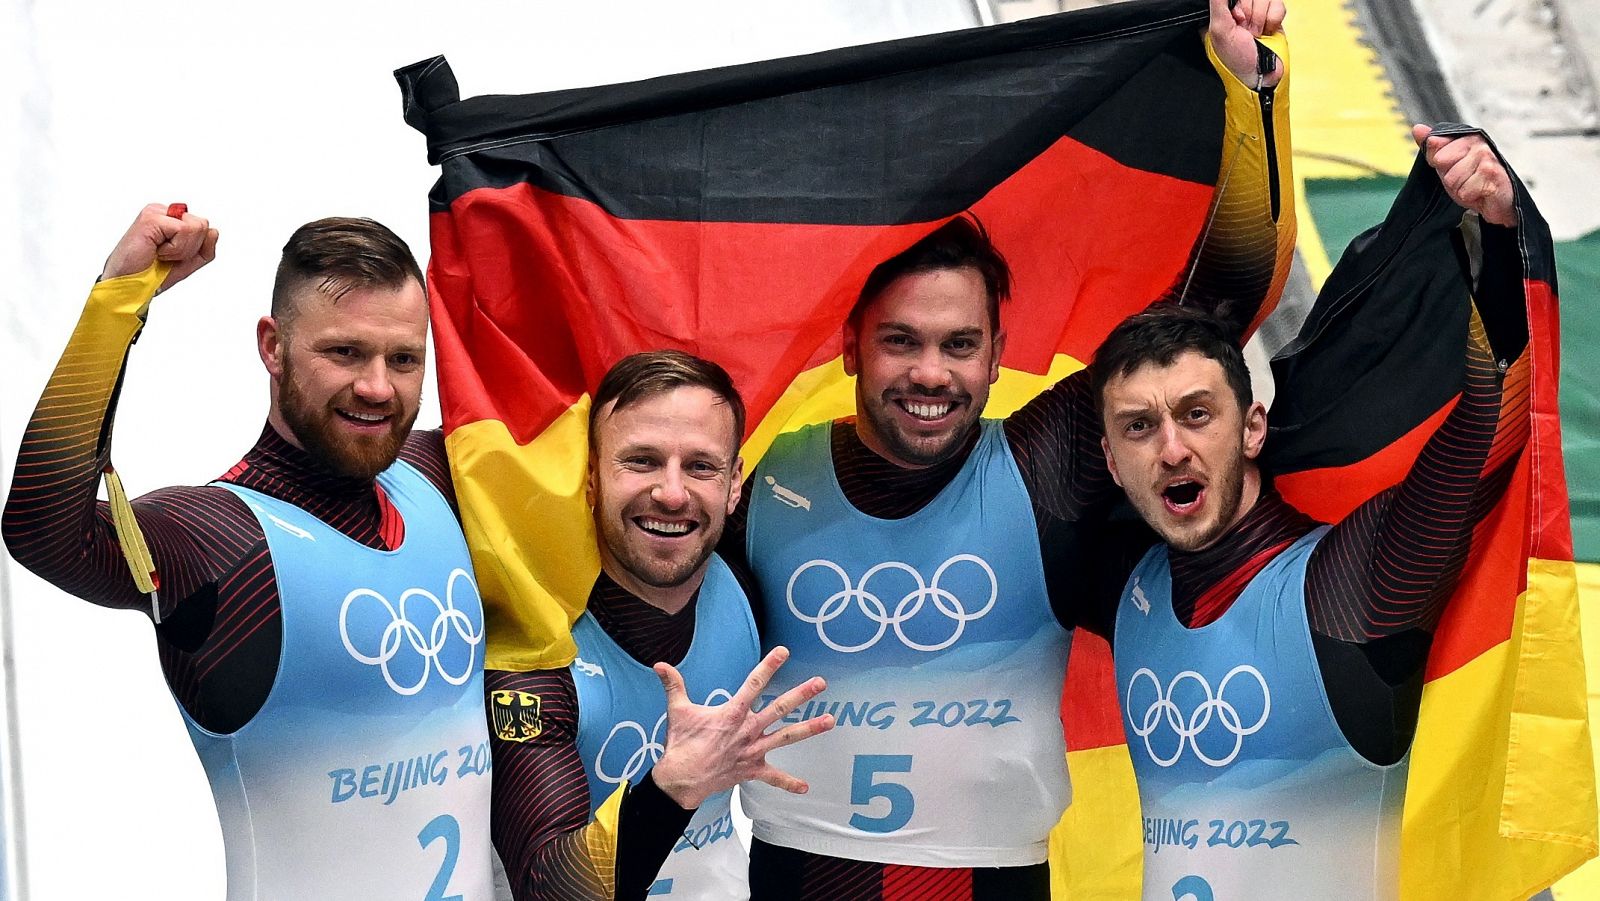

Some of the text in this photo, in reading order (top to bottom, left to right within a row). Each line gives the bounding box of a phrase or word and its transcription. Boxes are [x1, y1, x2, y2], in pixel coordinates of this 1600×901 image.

[909, 699, 1022, 728] 2022
[328, 750, 448, 805] BEIJING
[849, 754, 915, 833] 5
[417, 814, 463, 901] 2
[1207, 819, 1300, 849] 2022
